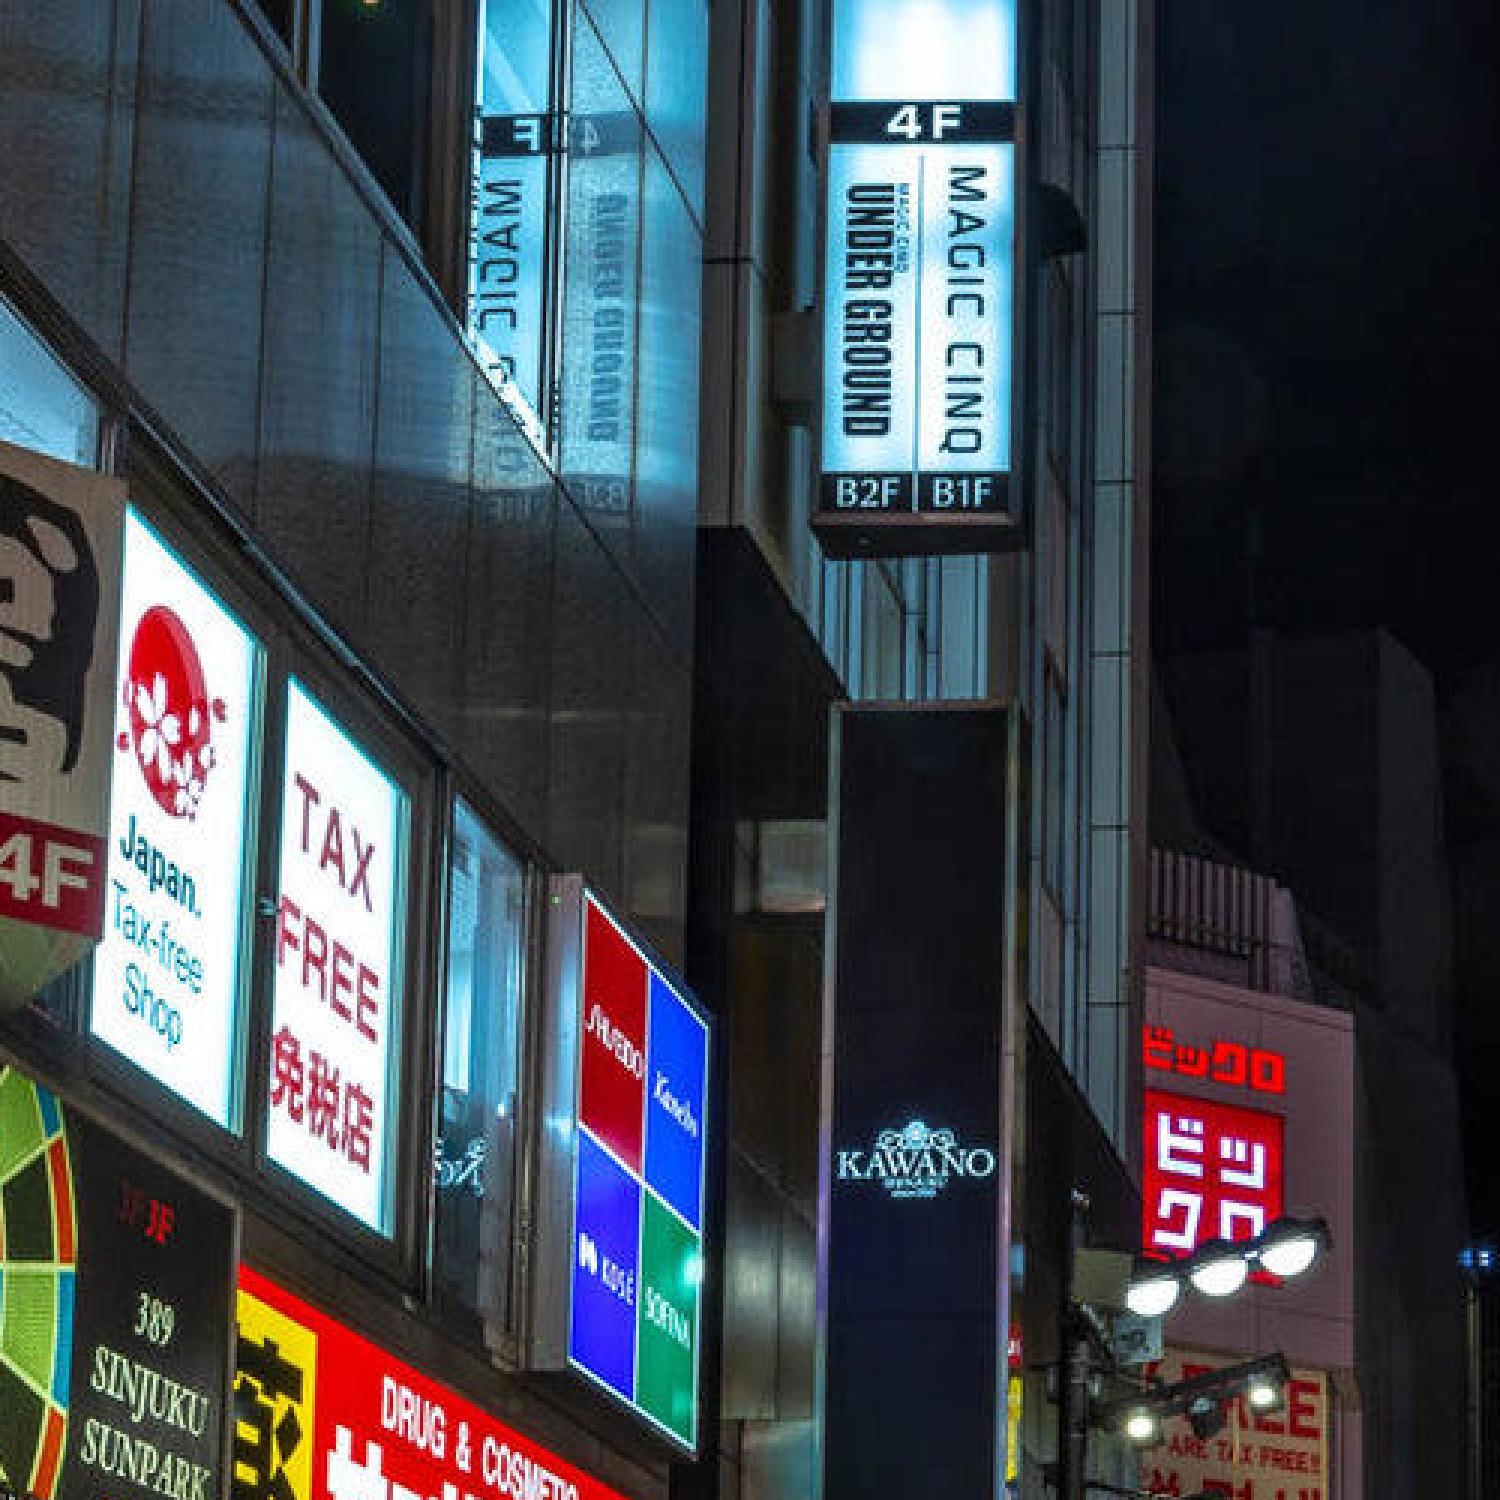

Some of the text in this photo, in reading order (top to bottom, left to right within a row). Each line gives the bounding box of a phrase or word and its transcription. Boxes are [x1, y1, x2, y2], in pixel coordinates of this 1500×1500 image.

[887, 104, 961, 139] 4F
[842, 182, 895, 438] UNDER GROUND
[939, 165, 988, 455] MAGIC CINQ
[835, 478, 900, 509] B2F
[931, 478, 992, 509] B1F
[0, 829, 93, 908] 4F
[294, 771, 375, 913] TAX
[111, 878, 204, 993] Tax-free
[278, 893, 379, 1044] FREE
[122, 962, 184, 1052] Shop
[272, 1024, 373, 1174] 免税店
[837, 1150, 995, 1179] KAWANO
[90, 1344, 209, 1438] SINJUKU
[381, 1375, 447, 1460] DRUG
[456, 1422, 472, 1474] &
